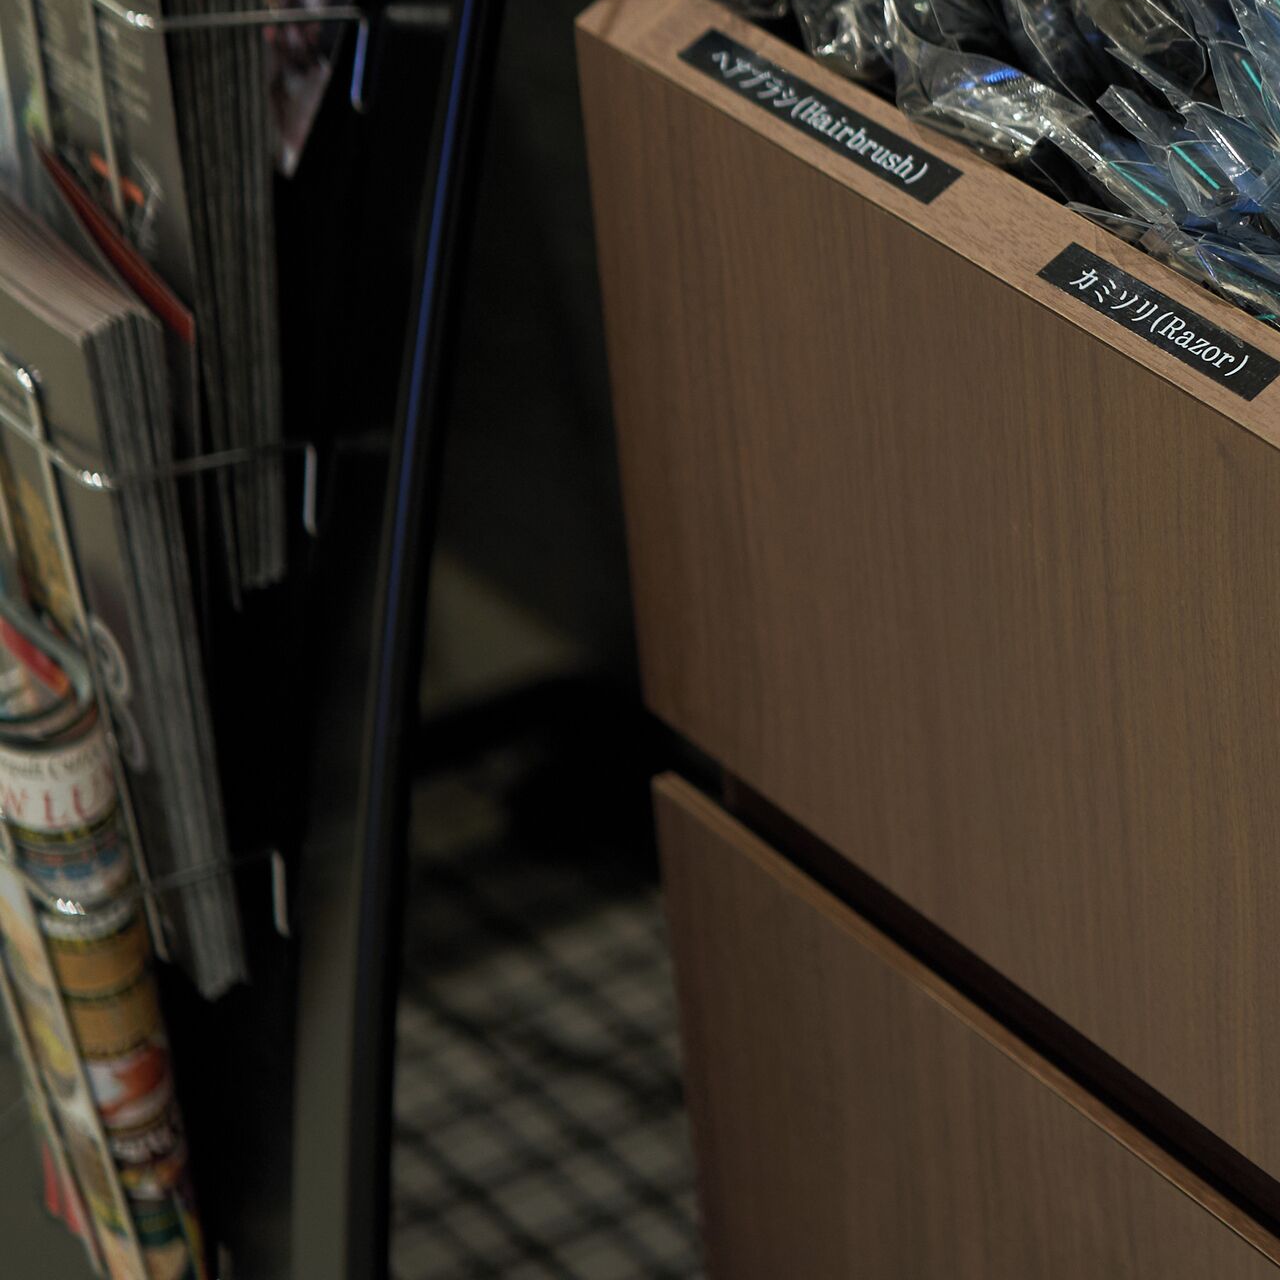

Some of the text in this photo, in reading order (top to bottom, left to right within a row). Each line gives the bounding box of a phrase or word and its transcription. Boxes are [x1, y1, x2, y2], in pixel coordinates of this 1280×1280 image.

[710, 48, 931, 186] ヘアブラシ(Hairbrush)
[1068, 266, 1252, 379] カミソリ(Razor)
